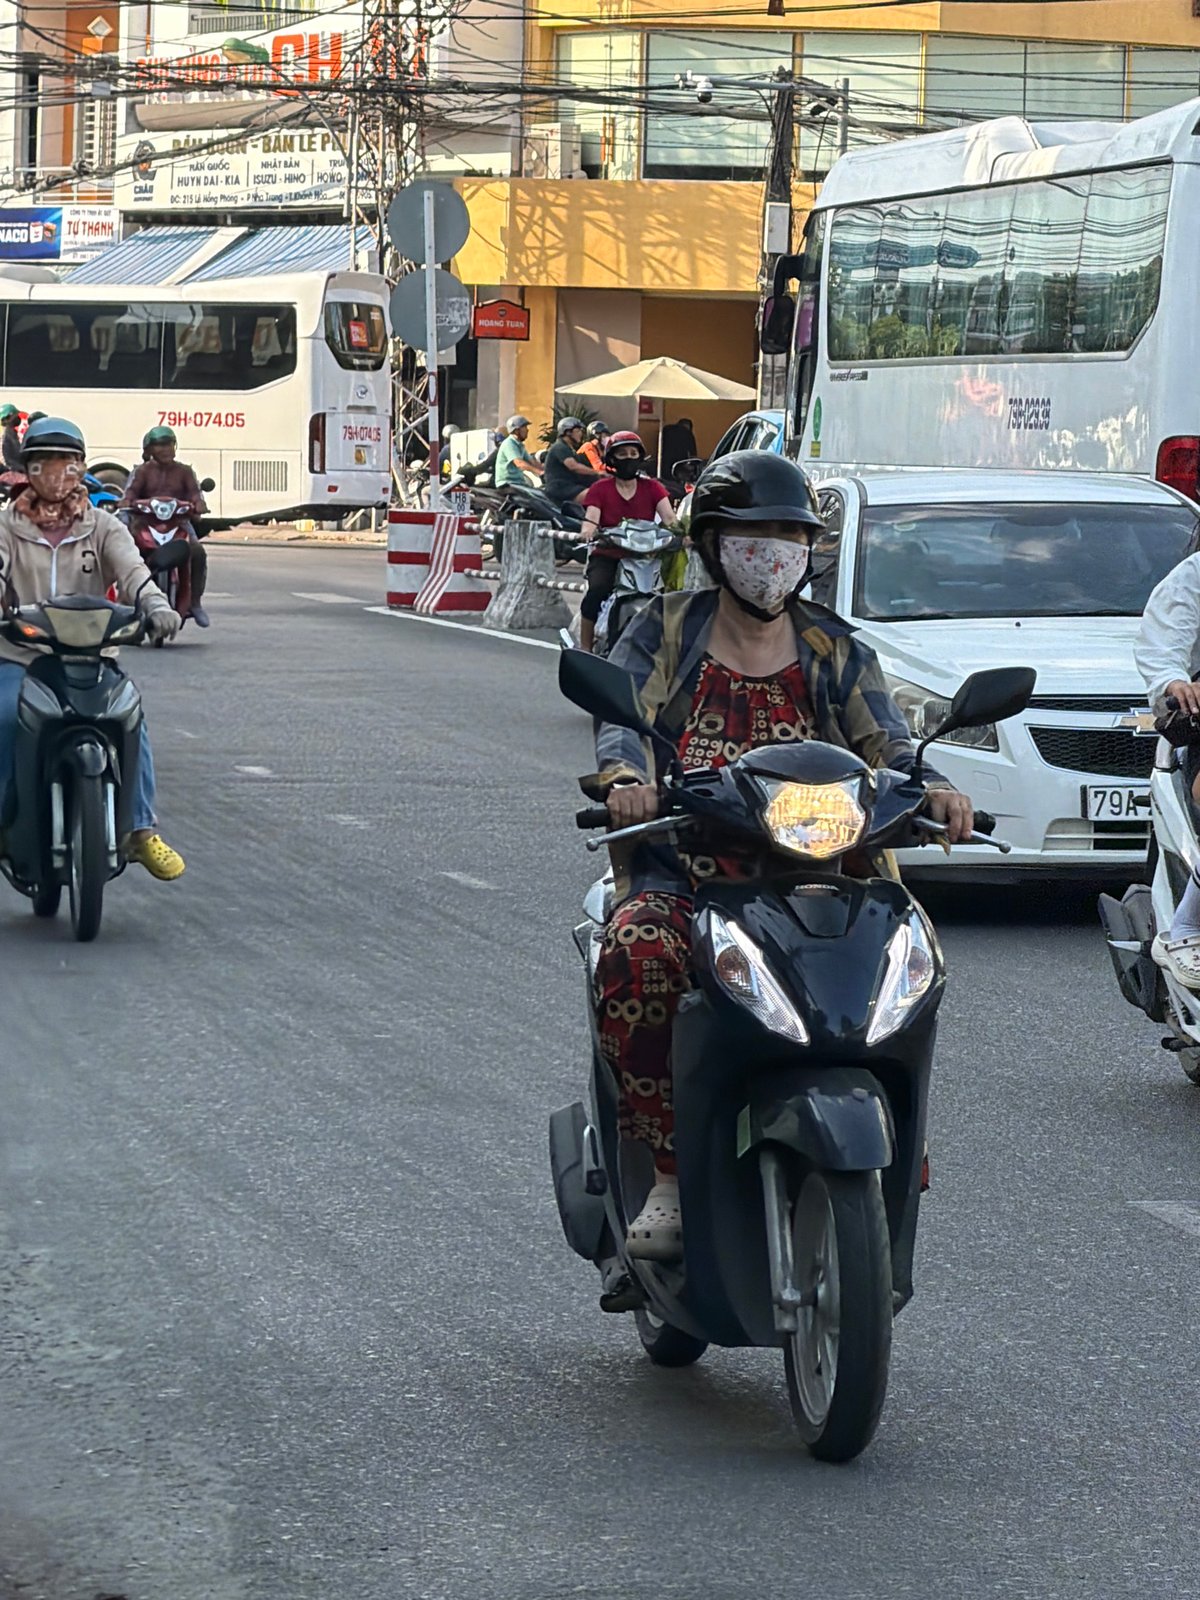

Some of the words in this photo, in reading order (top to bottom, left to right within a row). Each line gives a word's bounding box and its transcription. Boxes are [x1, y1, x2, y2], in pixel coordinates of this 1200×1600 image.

[225, 174, 240, 185] KIA
[253, 174, 277, 185] ISUZU
[284, 173, 306, 184] HINO
[317, 172, 342, 183] HOWO
[1093, 789, 1152, 817] 79A
